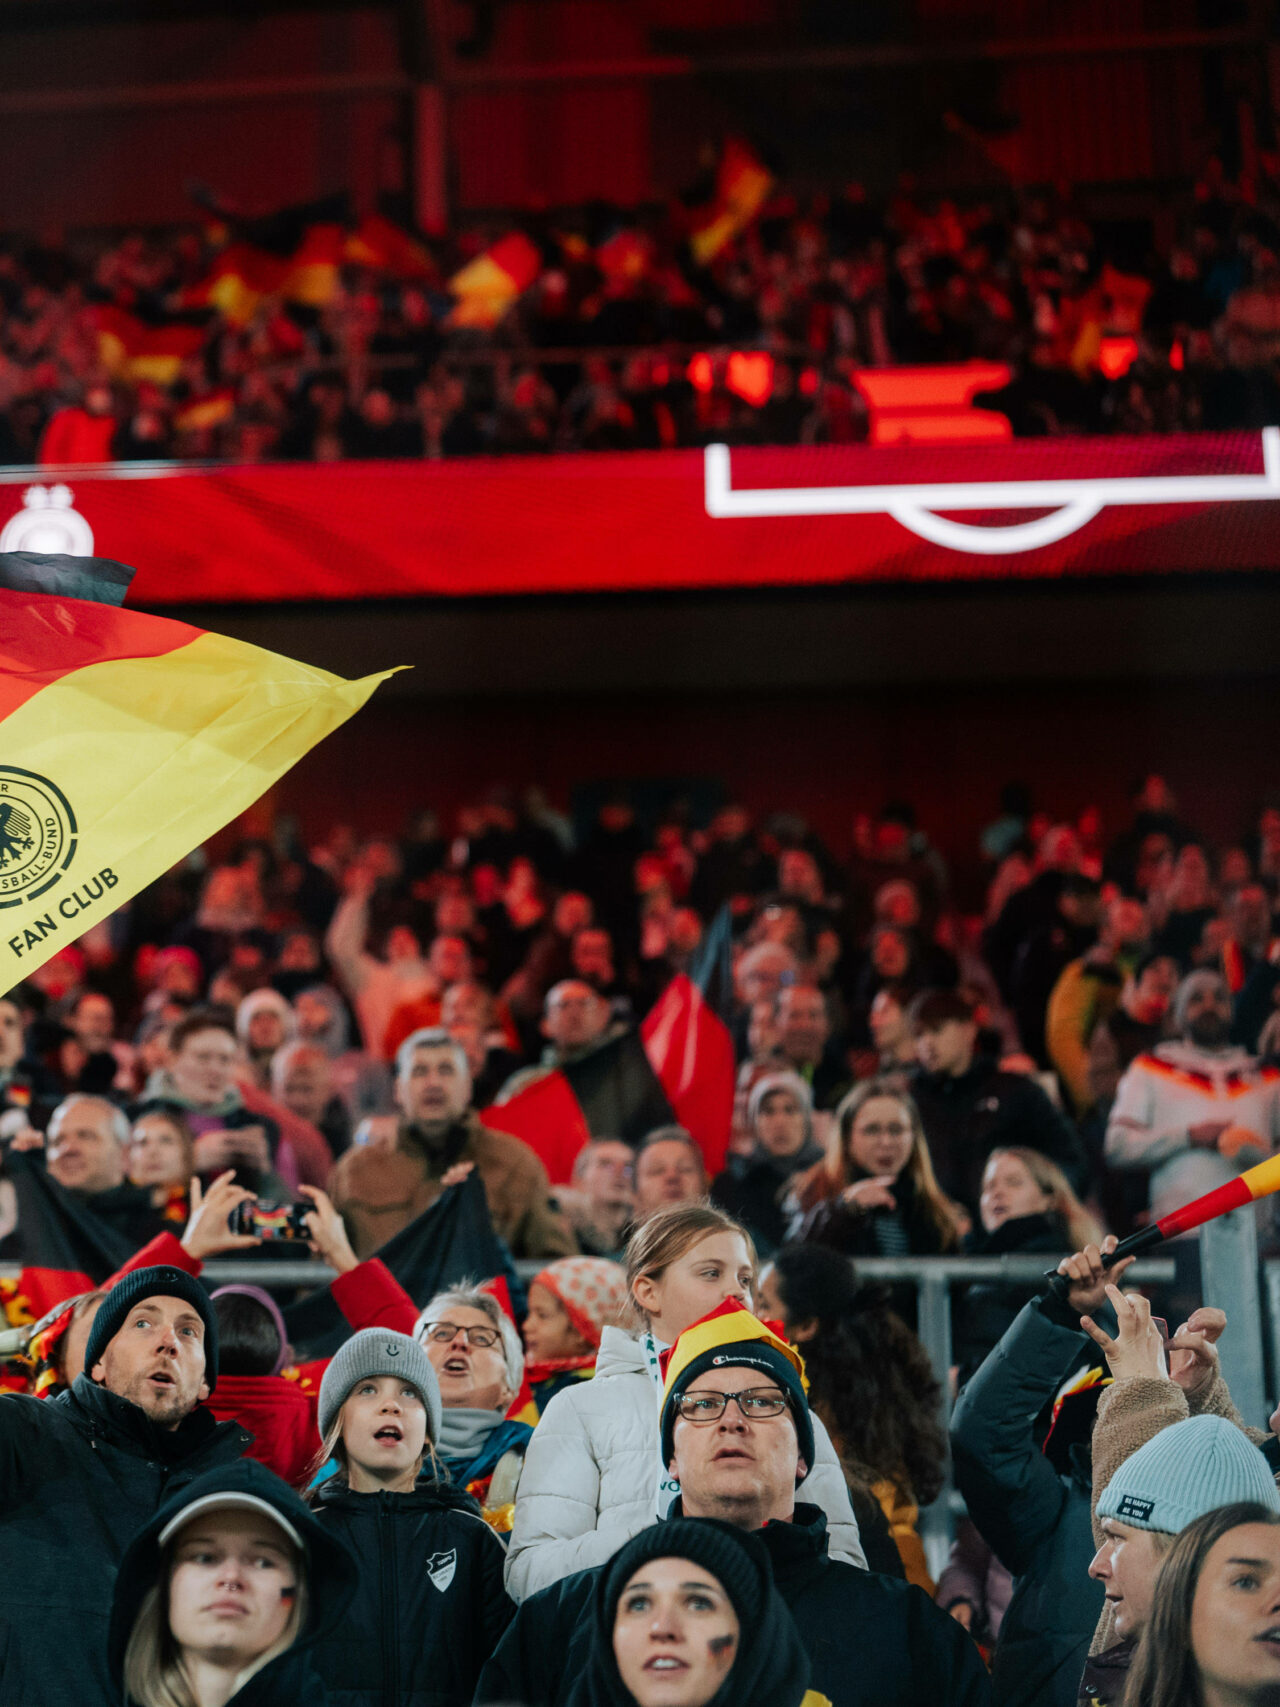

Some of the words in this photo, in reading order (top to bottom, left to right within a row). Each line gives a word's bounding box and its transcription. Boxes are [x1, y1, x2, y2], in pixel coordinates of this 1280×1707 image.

[8, 913, 58, 958] FAN
[59, 867, 119, 919] CLUB
[712, 1355, 774, 1369] Champion
[1124, 1497, 1132, 1505] BE
[1132, 1499, 1151, 1510] HAPPY
[1122, 1506, 1131, 1514] BE
[1132, 1509, 1144, 1517] YOU
